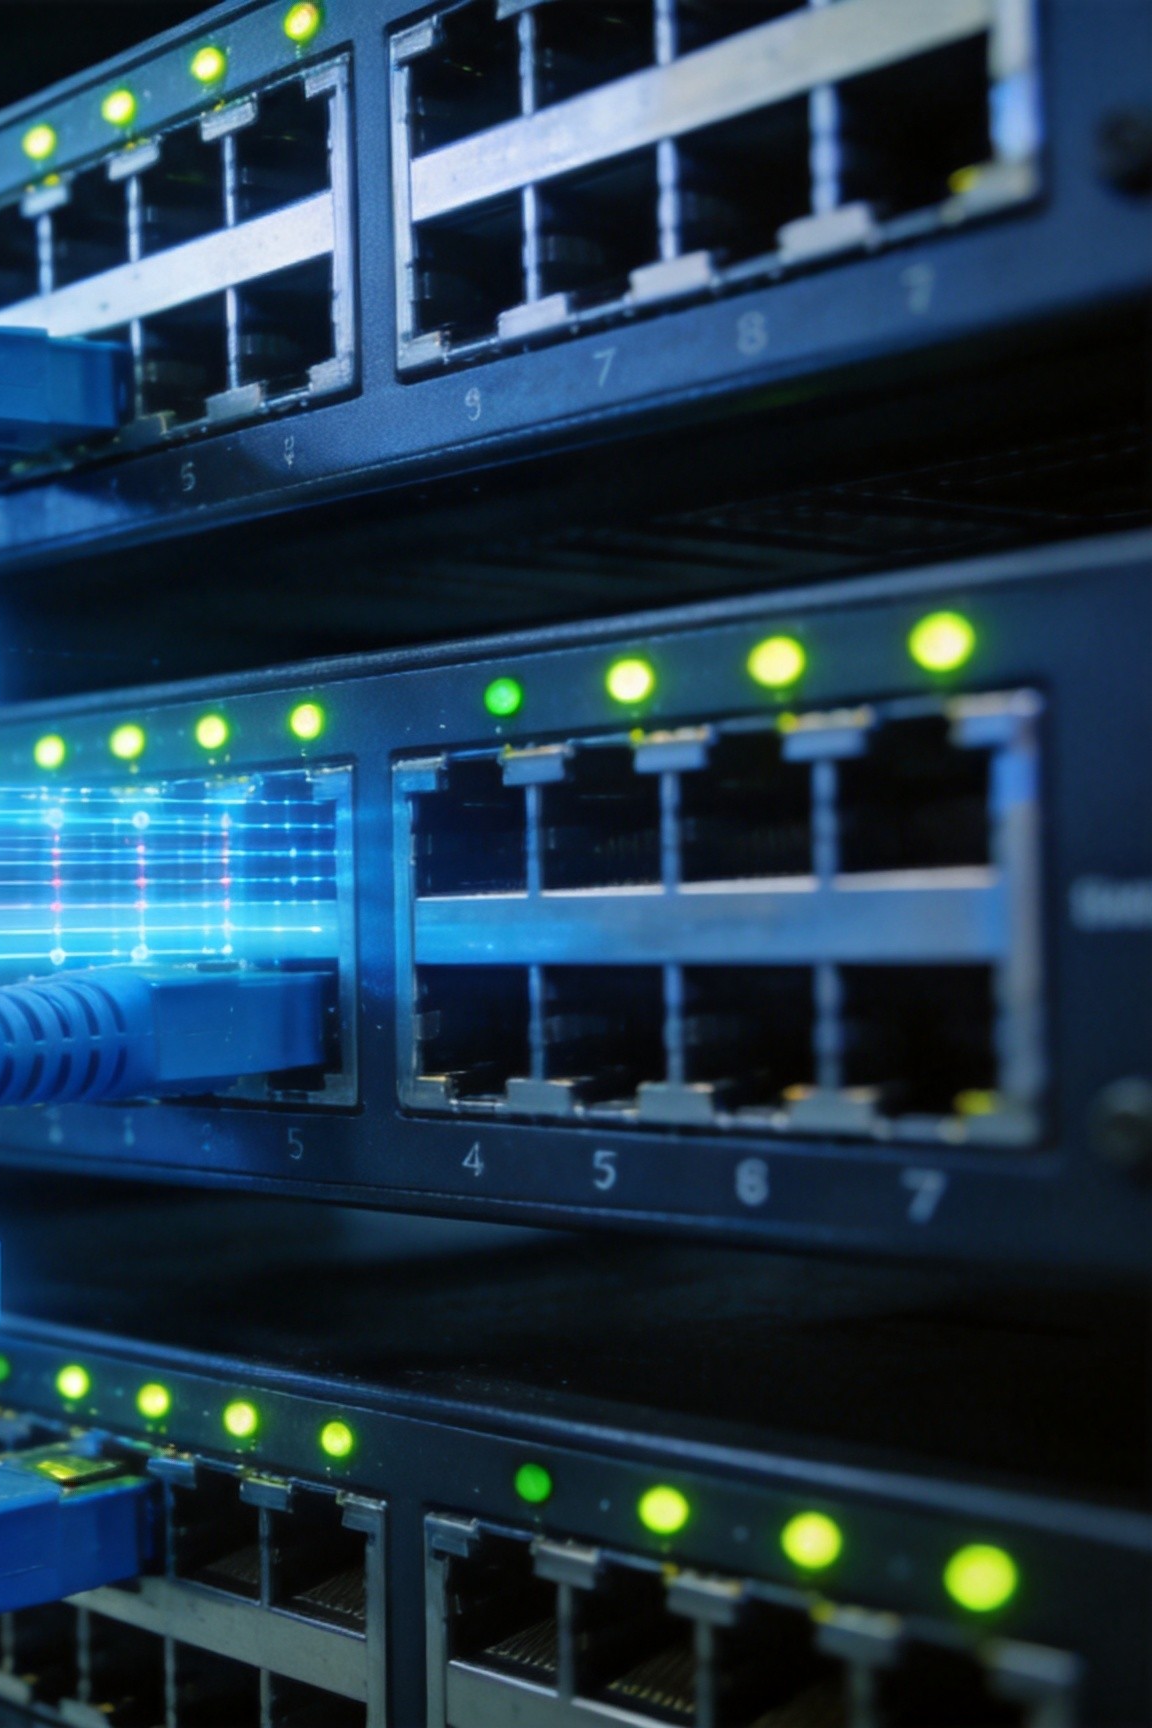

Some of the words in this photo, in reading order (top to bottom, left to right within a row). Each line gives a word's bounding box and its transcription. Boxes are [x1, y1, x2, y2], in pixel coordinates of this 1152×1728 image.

[593, 347, 616, 387] 7
[287, 1127, 304, 1160] 5
[461, 1141, 484, 1176] 4
[593, 1149, 617, 1190] 5
[902, 1168, 947, 1224] 7
